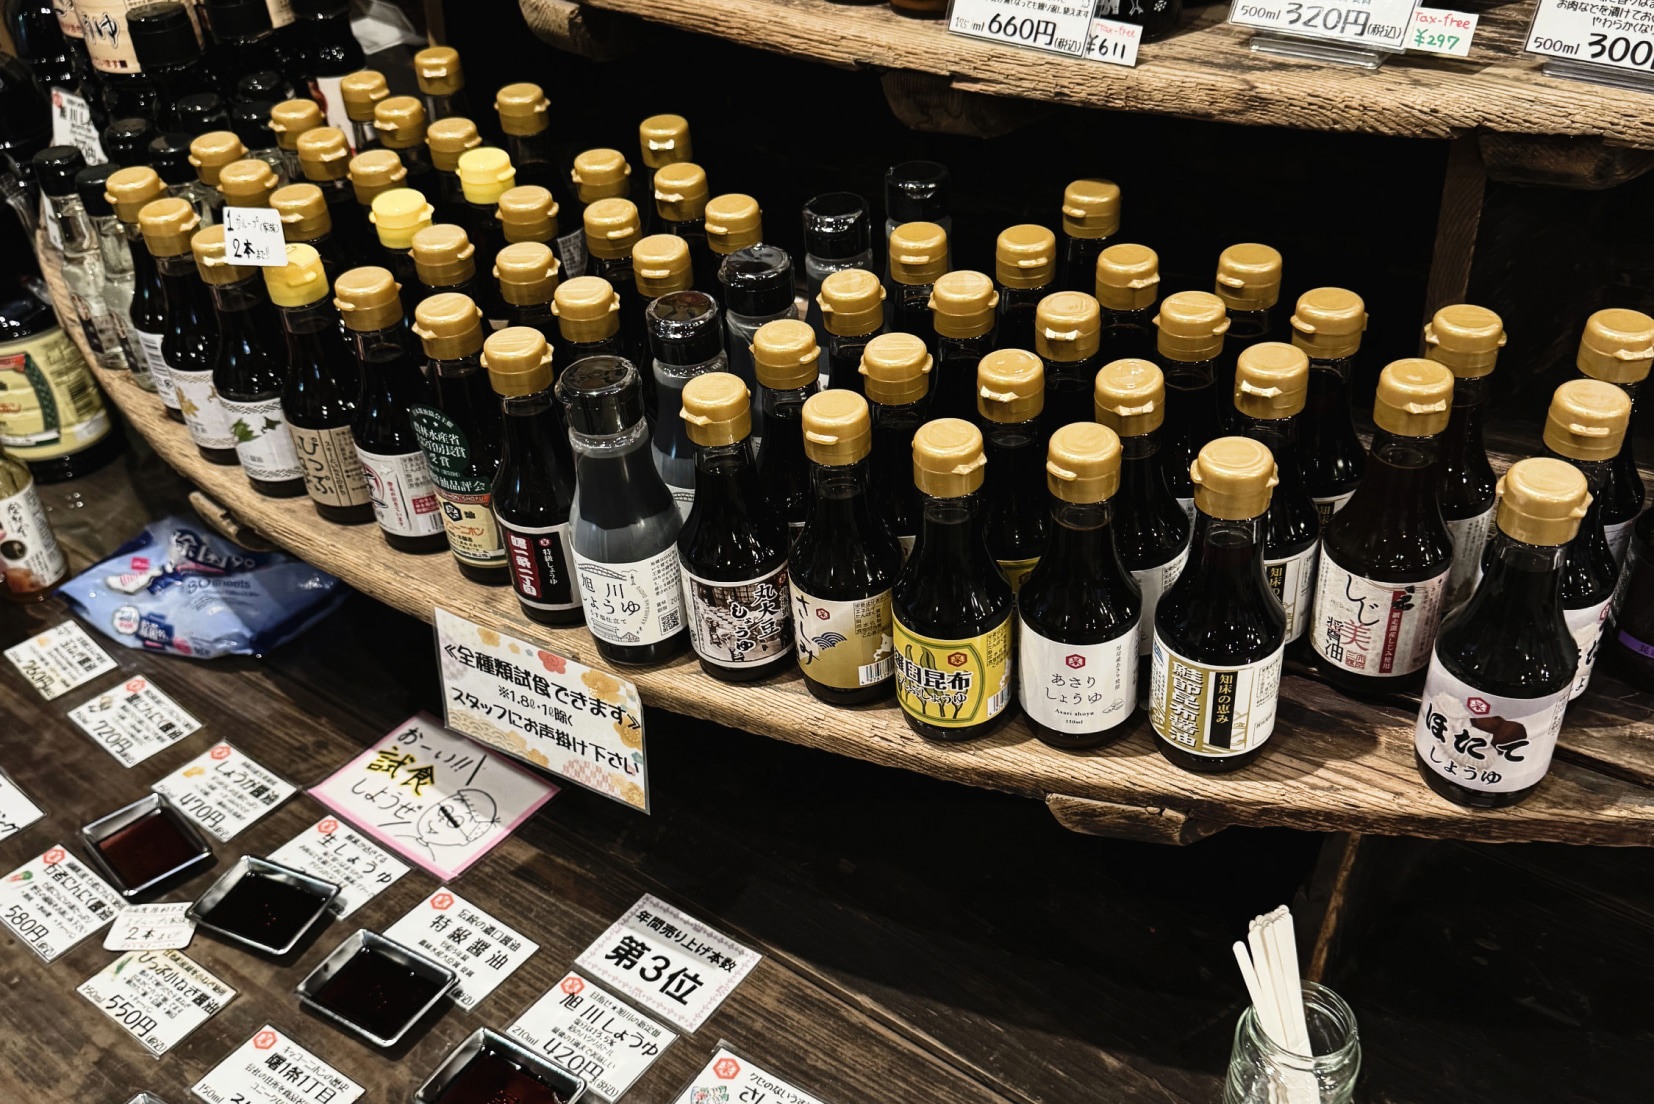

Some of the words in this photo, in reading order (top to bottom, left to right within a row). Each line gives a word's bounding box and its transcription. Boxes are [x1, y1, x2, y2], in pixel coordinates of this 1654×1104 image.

[988, 13, 1057, 46] 660円
[1240, 5, 1281, 20] 500ml
[1286, 2, 1371, 36] 320円
[1367, 23, 1402, 39] (税込)
[1415, 29, 1460, 49] ¥297
[1534, 37, 1580, 55] 500ml
[1588, 33, 1654, 70] 300
[731, 603, 756, 652] しょうゆ
[751, 584, 780, 639] 丸大豆
[1045, 686, 1103, 705] しょうゆ
[1051, 673, 1096, 689] あさり
[1215, 673, 1233, 724] 知床の恵み
[451, 686, 640, 775] スタッフにお声掛け下さい
[1425, 703, 1529, 762] ほたて
[366, 746, 436, 796] 試食
[1430, 745, 1502, 785] しょうゆ
[179, 792, 226, 830] 470円
[317, 833, 392, 884] 生しょうゆ
[5, 904, 50, 943] 580円
[430, 914, 509, 971] 特級醤油
[635, 909, 737, 973] 年間売り上げ本数
[605, 935, 704, 1006] 第3位
[106, 994, 158, 1038] 550円
[559, 992, 659, 1056] 旭川しょうゆ
[264, 1052, 337, 1104] 曙1条1丁目
[511, 1025, 540, 1047] 210ml
[543, 1037, 605, 1084] 420円
